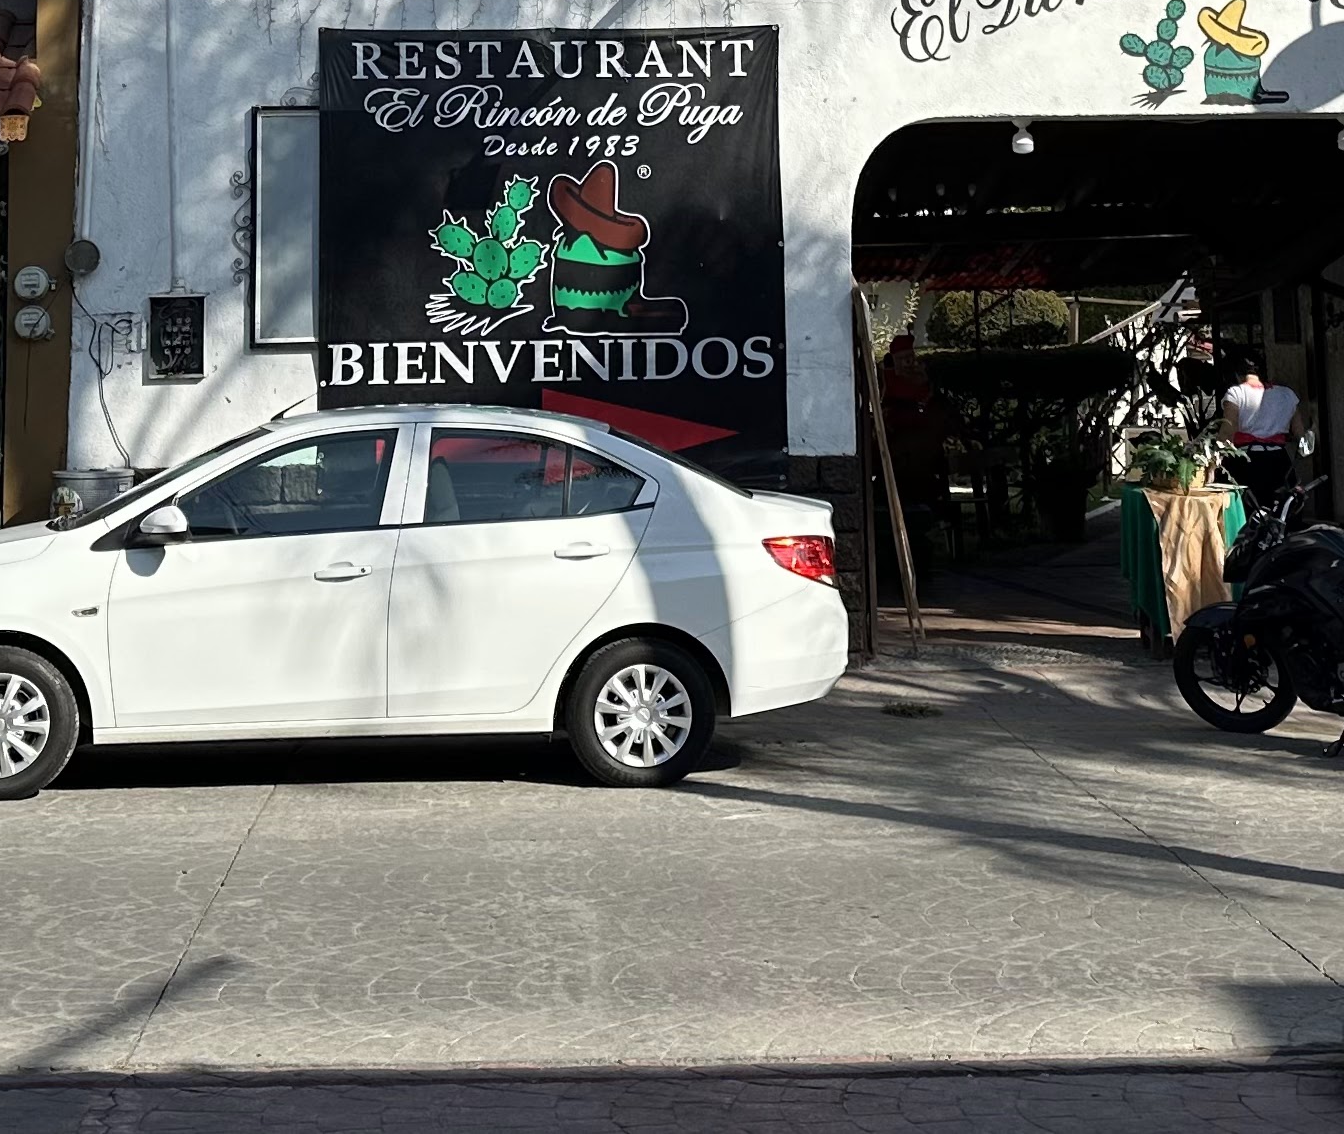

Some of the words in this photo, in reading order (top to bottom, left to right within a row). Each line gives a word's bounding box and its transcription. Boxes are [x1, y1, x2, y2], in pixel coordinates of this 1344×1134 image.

[351, 39, 755, 80] RESTAURANT
[363, 87, 423, 132] El
[434, 83, 581, 130] Rincón
[586, 92, 627, 128] de
[637, 82, 744, 144] Puga
[484, 135, 558, 157] Desde
[568, 135, 640, 157] 1983
[327, 336, 774, 387] BIENVENIDOS
